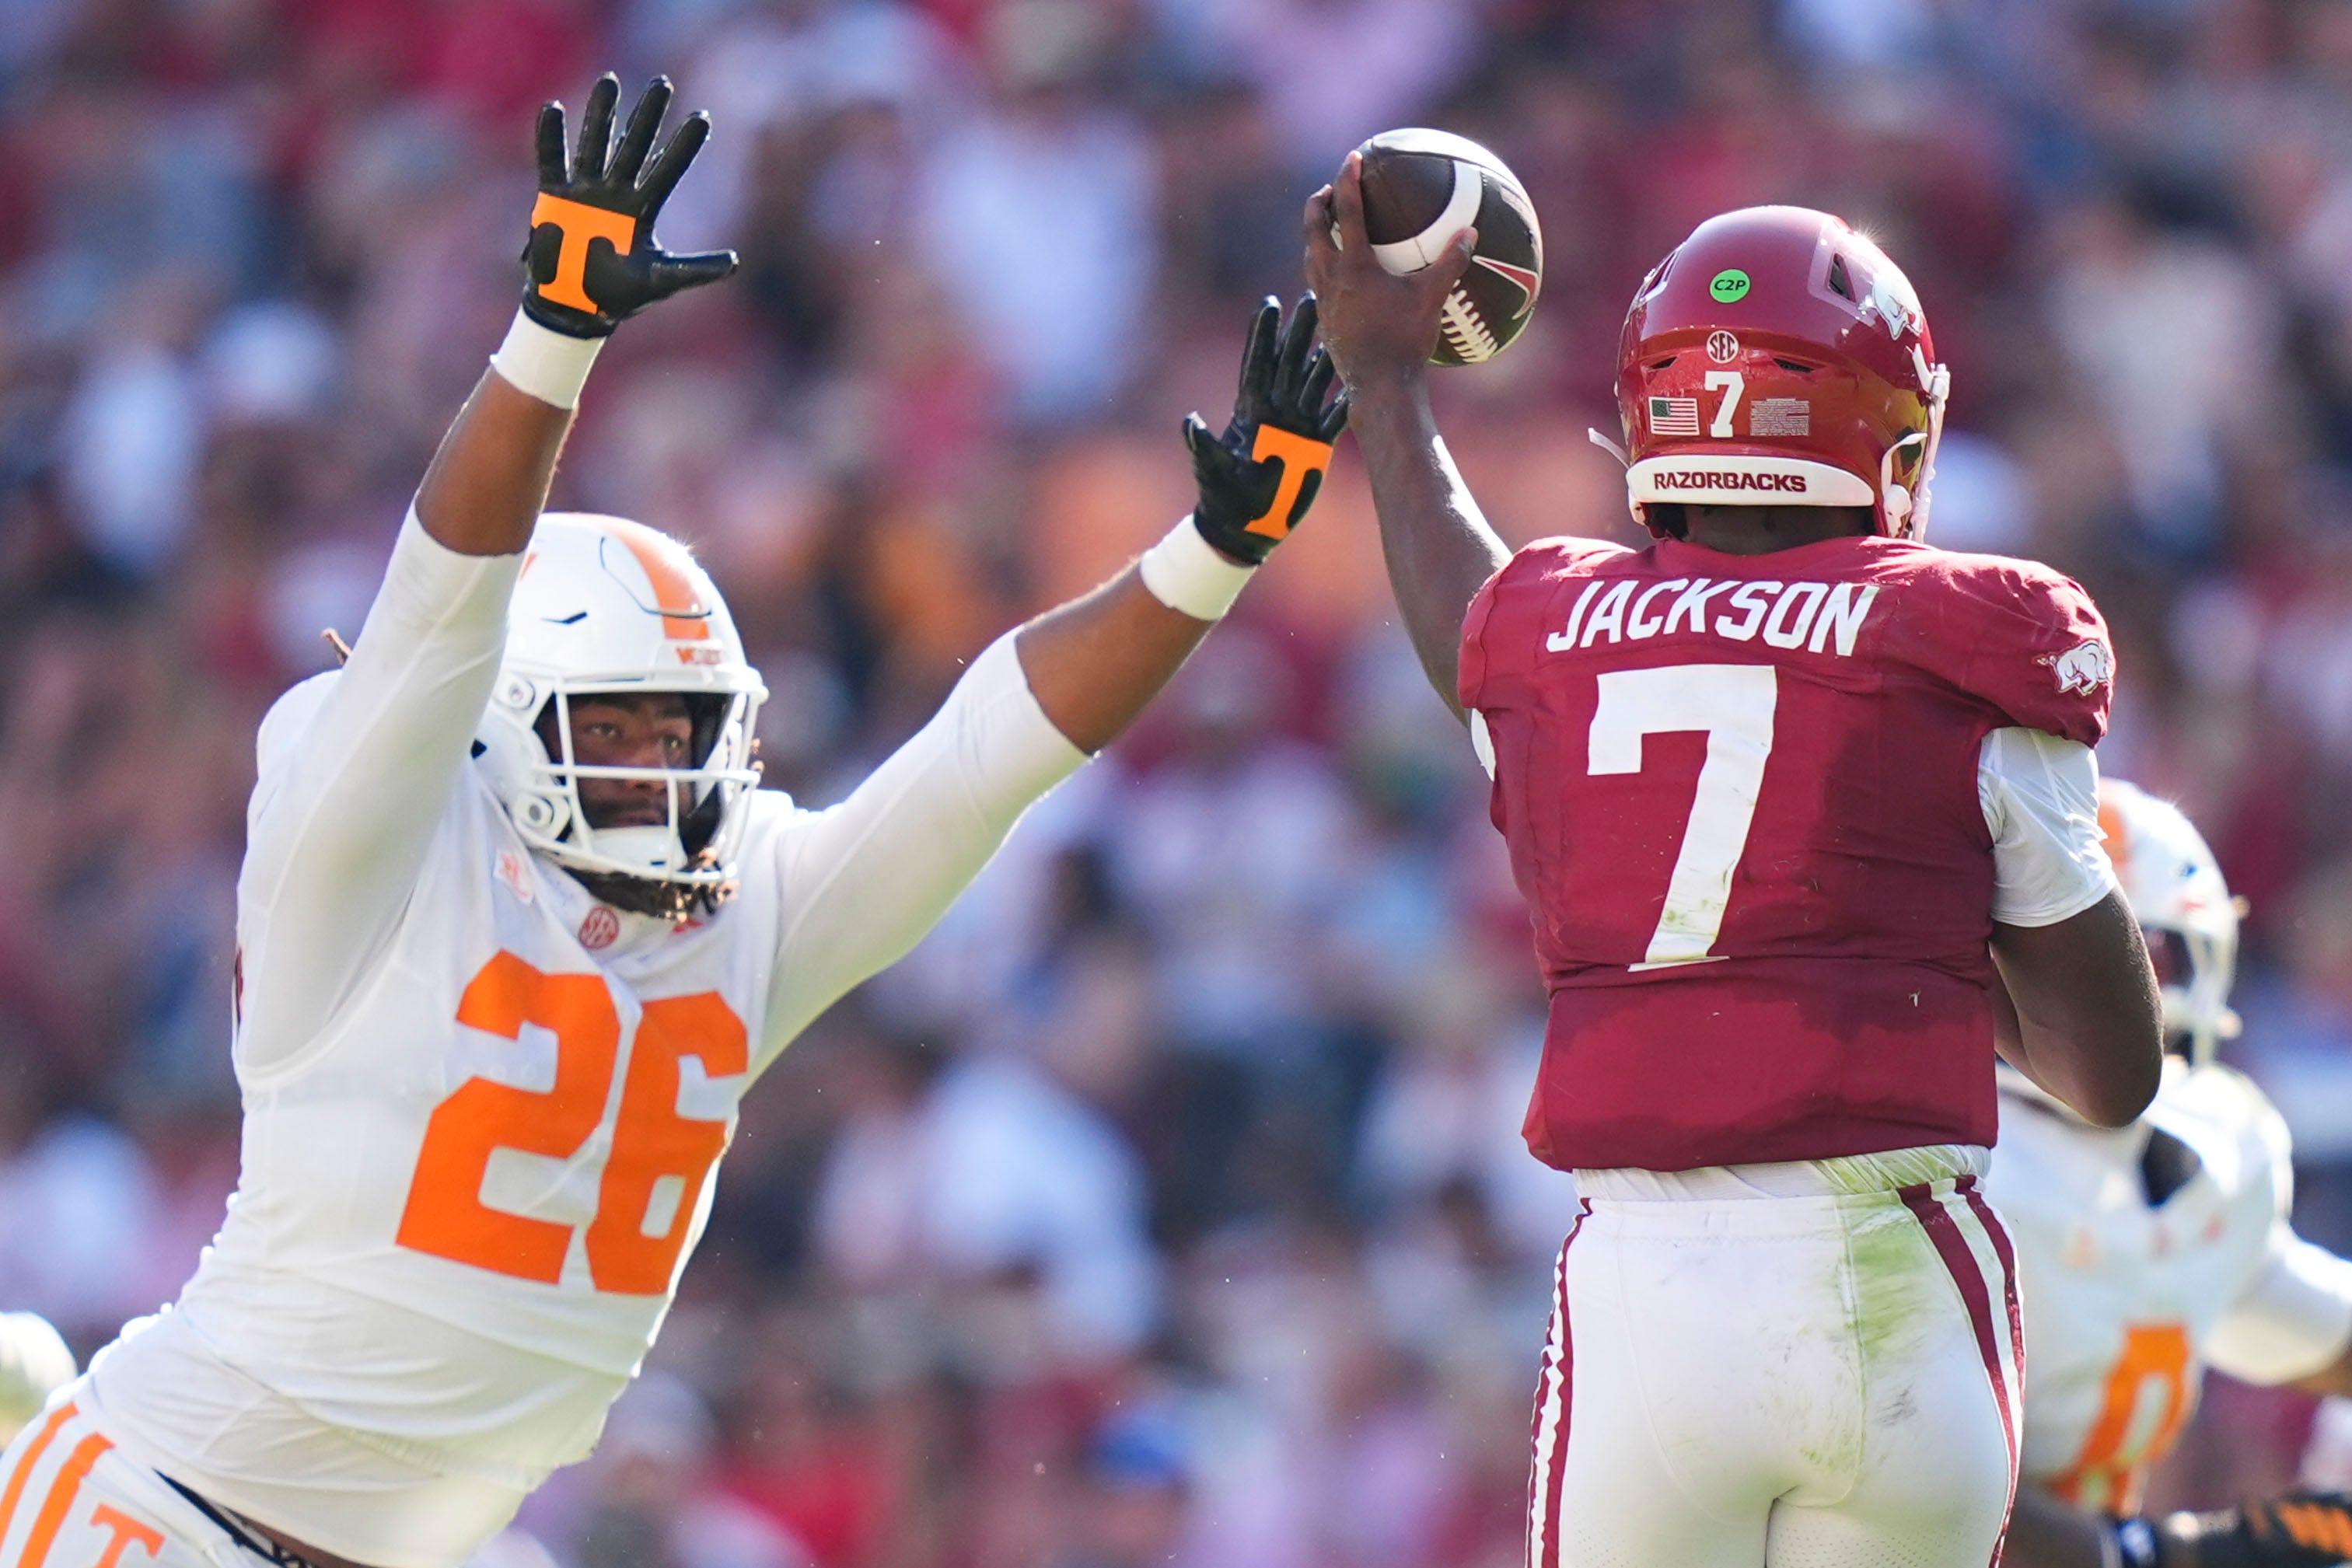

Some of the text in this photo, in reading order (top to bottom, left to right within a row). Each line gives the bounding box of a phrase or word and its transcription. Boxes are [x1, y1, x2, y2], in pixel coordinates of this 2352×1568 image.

[531, 190, 636, 315] T
[1714, 279, 1746, 292] C2P
[1708, 333, 1737, 362] SEC
[1704, 370, 1745, 438] 7
[1244, 423, 1333, 540] T
[1653, 471, 1807, 493] RAZORBACKS
[1546, 578, 1880, 657] JACKSON
[1587, 663, 1777, 973] 7
[394, 948, 749, 1297] 26
